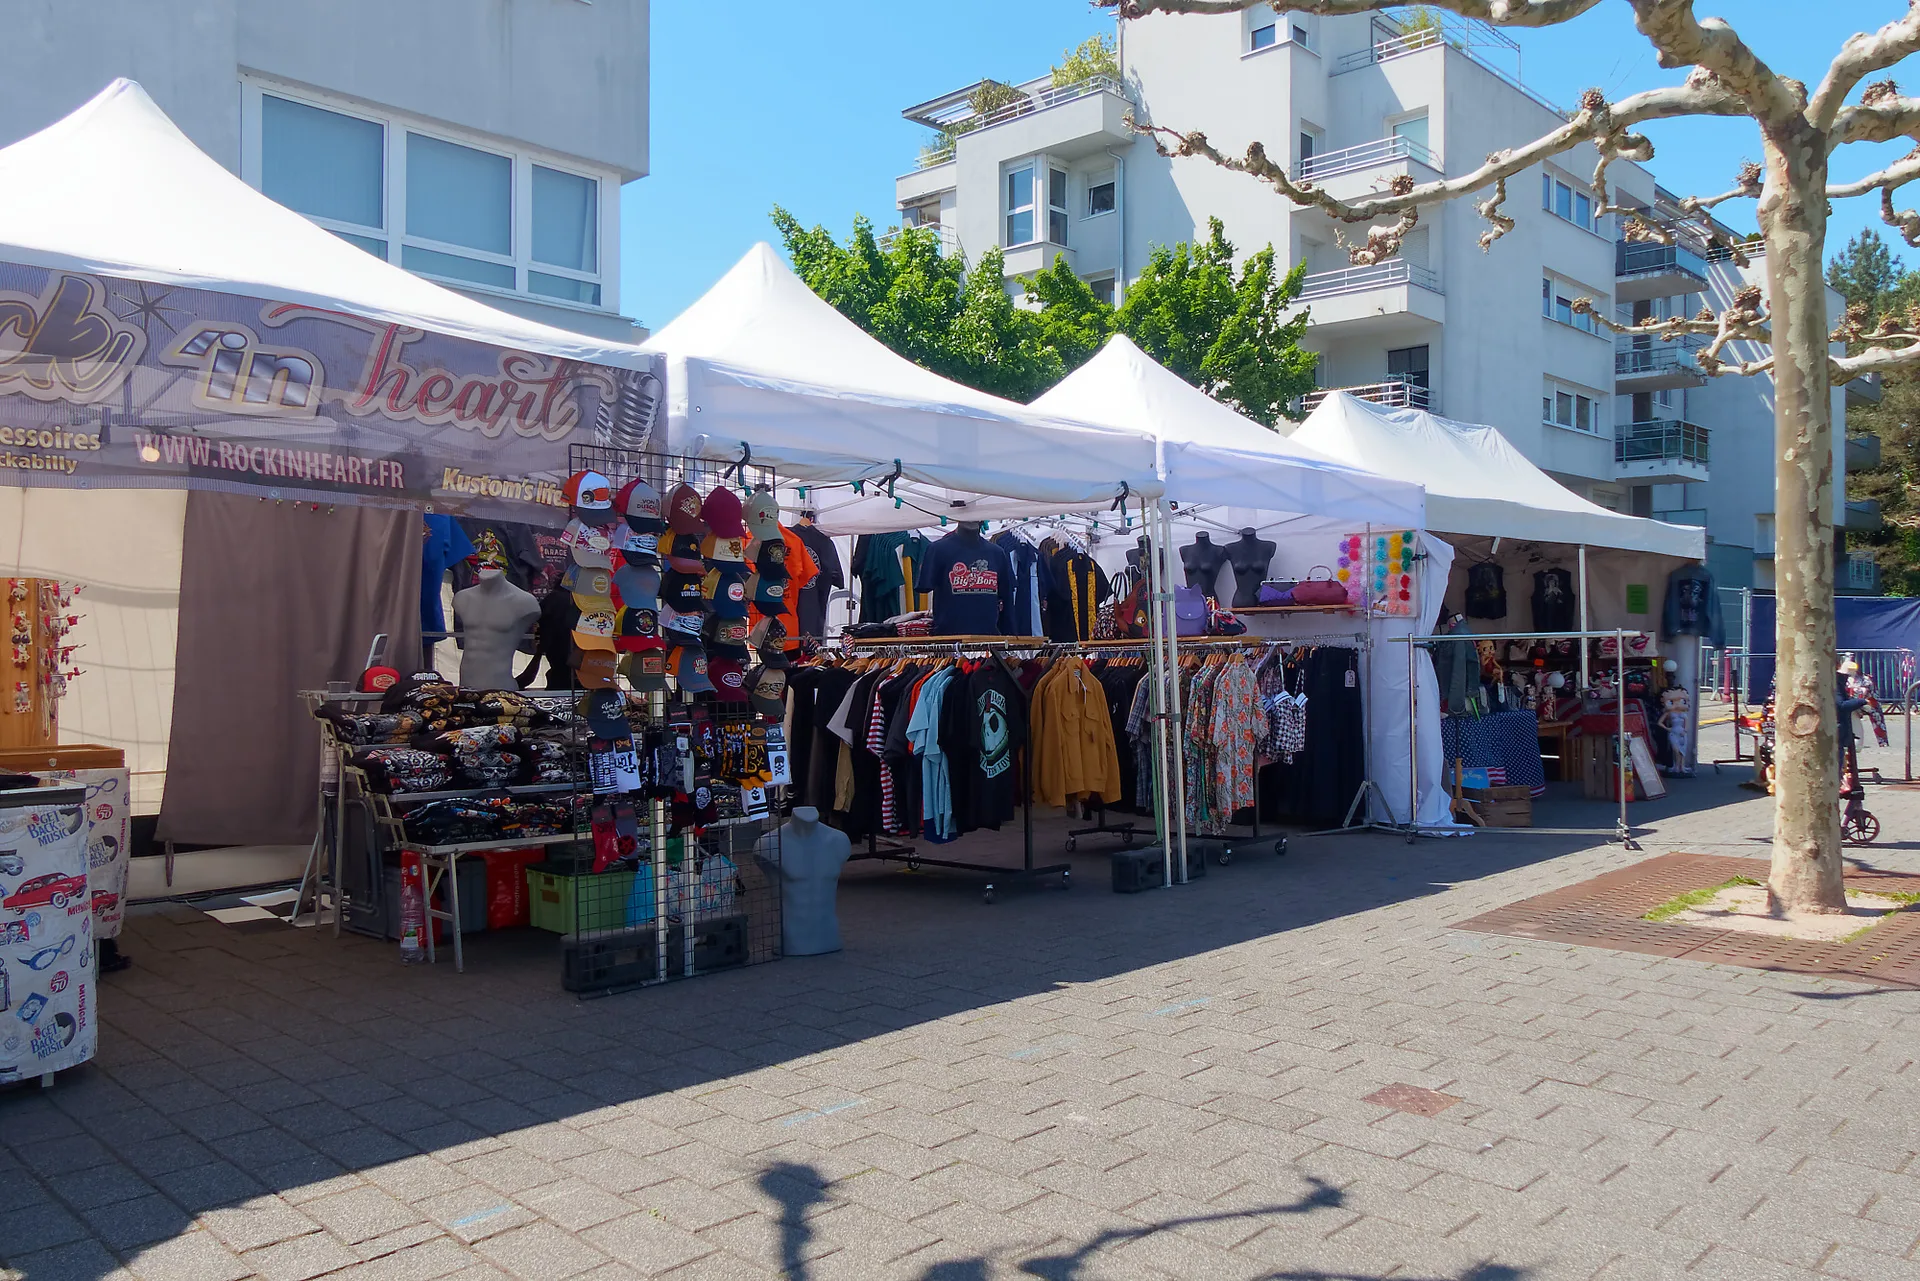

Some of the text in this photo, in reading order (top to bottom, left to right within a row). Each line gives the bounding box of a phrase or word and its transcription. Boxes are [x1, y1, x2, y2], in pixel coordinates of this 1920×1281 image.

[0, 426, 101, 450] essoires
[134, 433, 404, 489] WWW.ROCKINHEART.FR
[442, 467, 535, 501] Kustom's
[953, 576, 998, 587] Big Bore
[584, 612, 599, 622] VON
[40, 810, 60, 824] GET
[27, 821, 59, 839] BACK
[37, 827, 70, 847] MUSIC
[90, 850, 104, 861] ACK
[41, 1022, 57, 1038] GET
[30, 1033, 56, 1054] BACK
[37, 1040, 65, 1060] MUSIC
